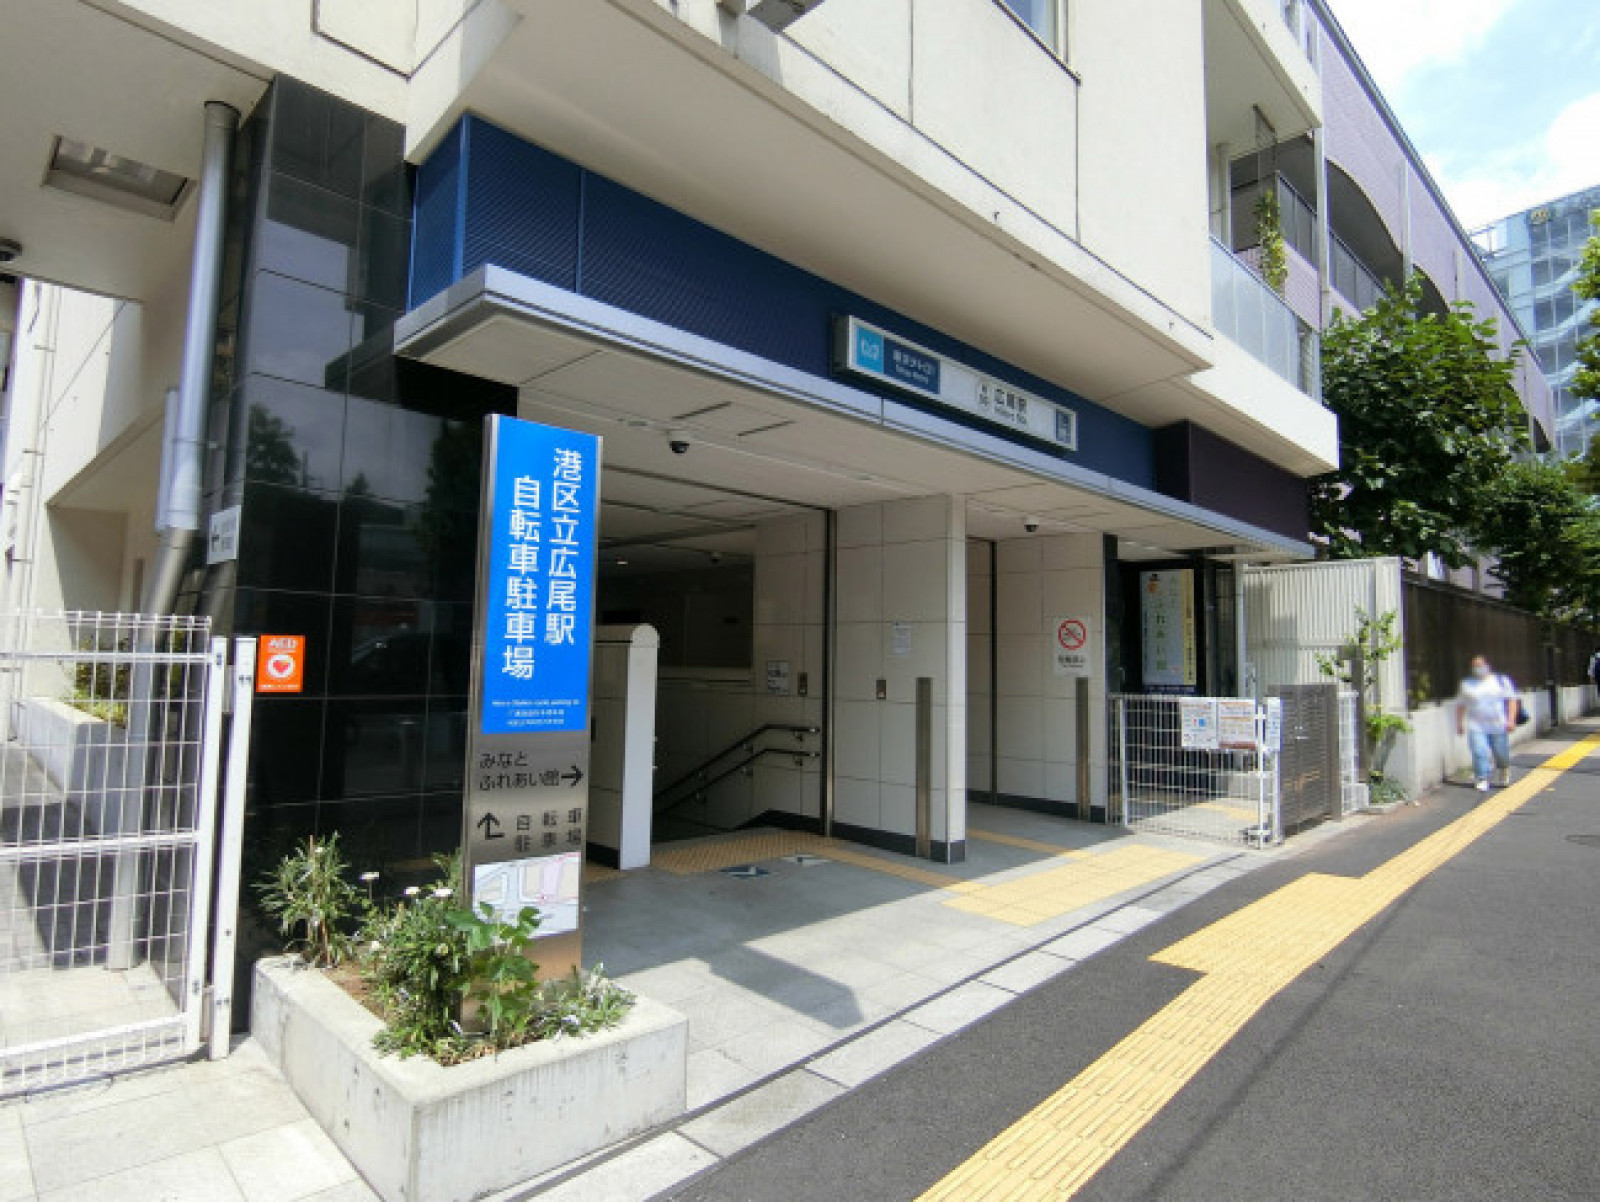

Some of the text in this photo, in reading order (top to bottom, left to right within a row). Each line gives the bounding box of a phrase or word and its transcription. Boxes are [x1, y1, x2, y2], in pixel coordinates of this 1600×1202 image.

[501, 474, 542, 681] 自転車駐車場
[544, 447, 582, 646] 港区立広尾駅
[479, 751, 529, 769] みなと
